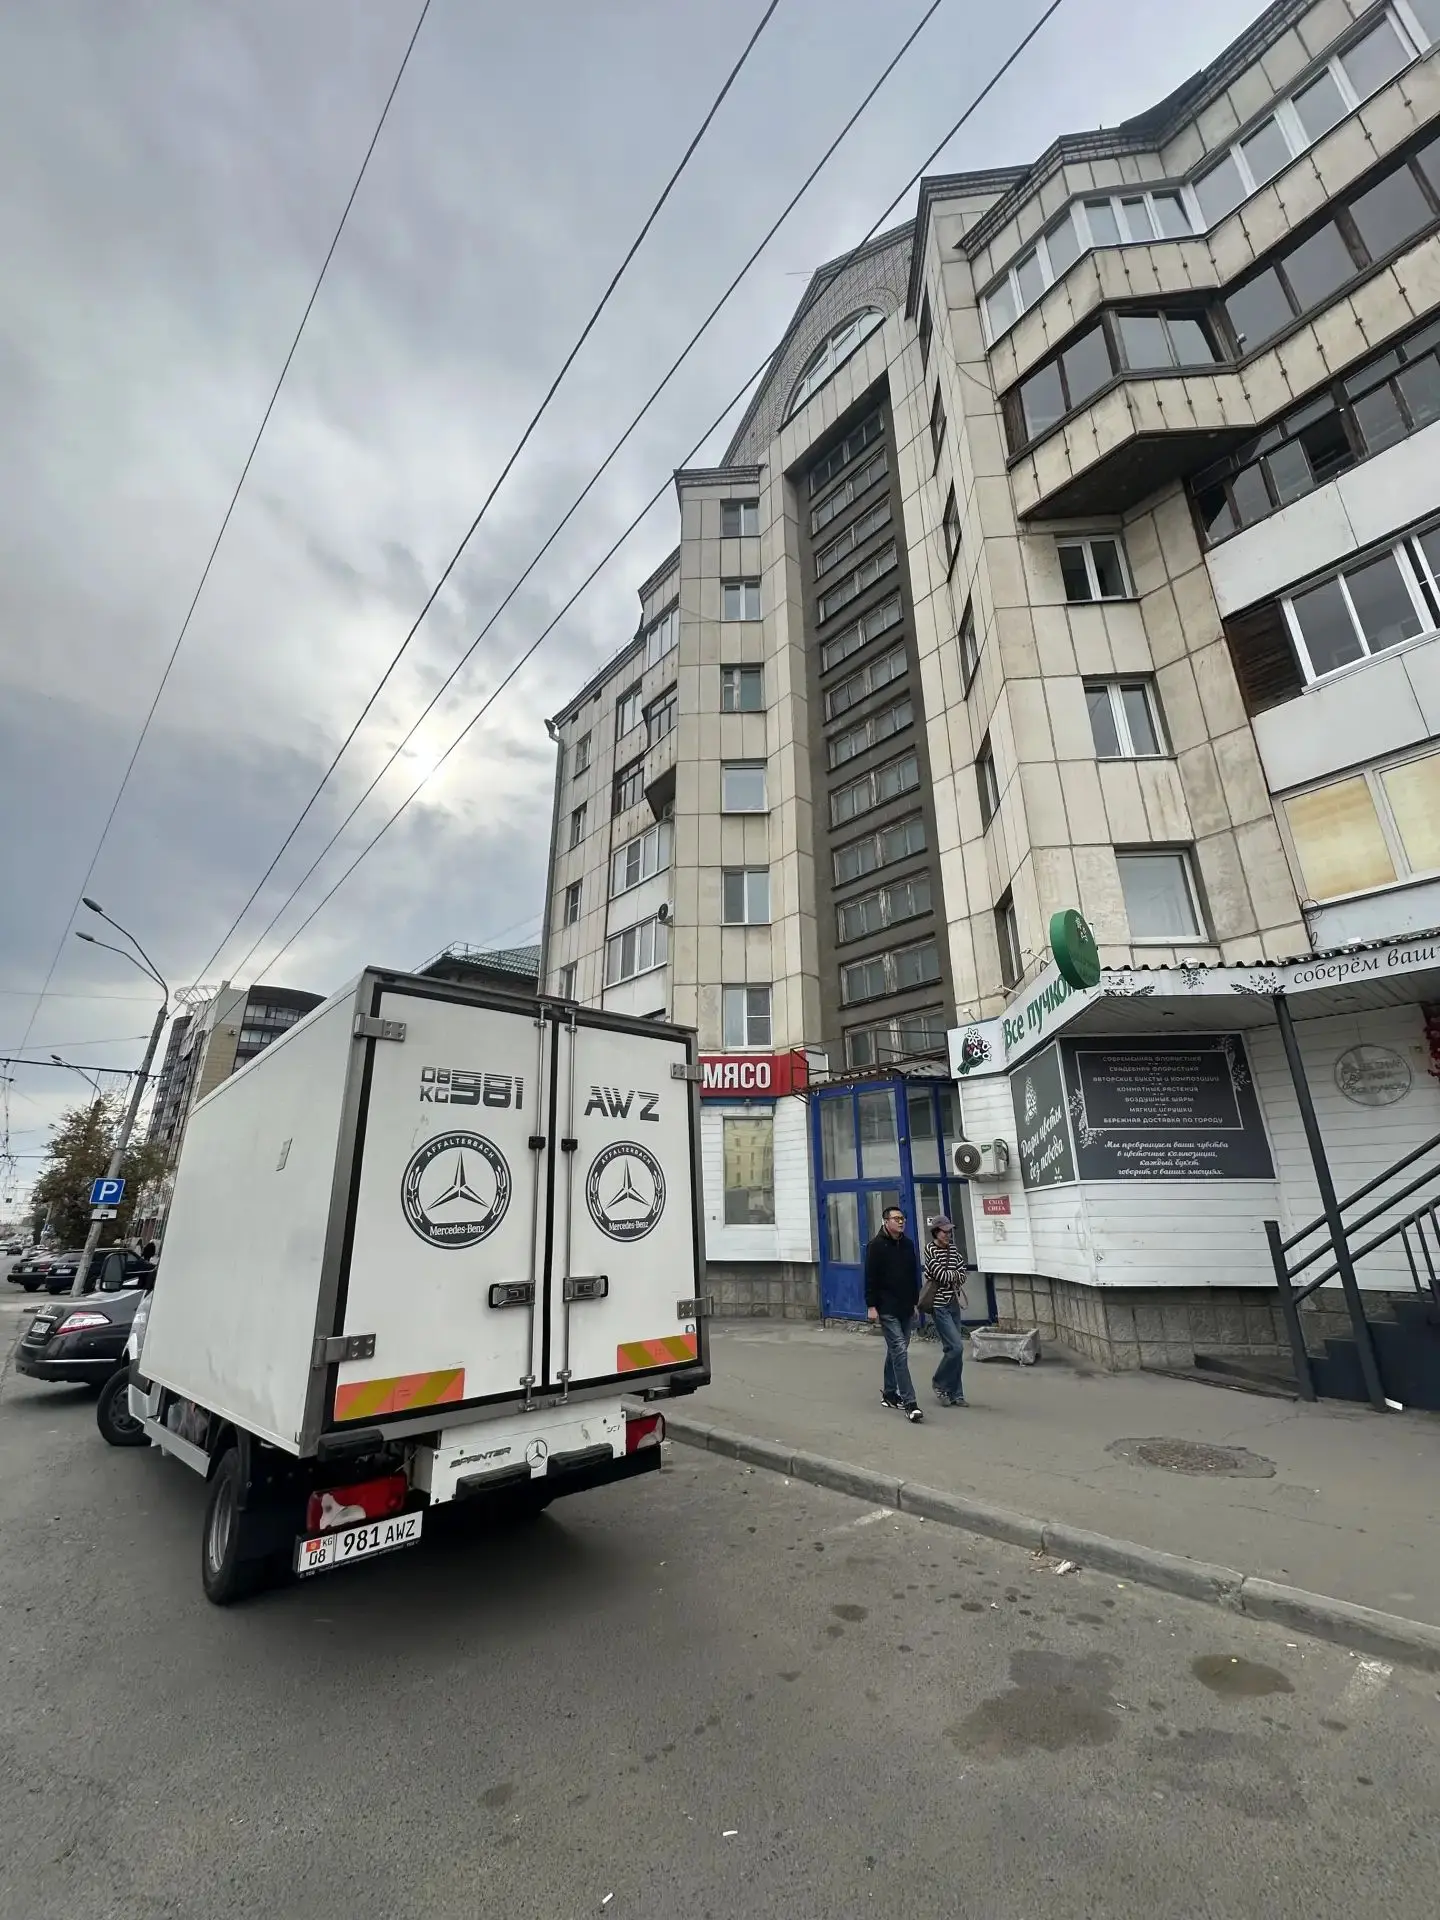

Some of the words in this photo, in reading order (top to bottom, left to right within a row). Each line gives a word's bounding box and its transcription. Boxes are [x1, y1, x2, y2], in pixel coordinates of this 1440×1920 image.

[1293, 956, 1380, 984] соберём
[1387, 945, 1440, 967] ваш
[1002, 1014, 1025, 1049] Все
[702, 1062, 771, 1089] МЯСО
[419, 1085, 450, 1104] KG
[450, 1069, 524, 1110] 981
[583, 1085, 660, 1122] AWZ
[1021, 1131, 1040, 1158] Дари
[1039, 1104, 1062, 1142] цветы
[426, 1137, 495, 1159] AFFALTERBACH
[1040, 1134, 1064, 1172] повода
[1104, 1140, 1120, 1148] Мы
[1121, 1141, 1172, 1150] превращаем
[1173, 1140, 1195, 1148] ваши
[1196, 1140, 1229, 1150] чувства
[1123, 1150, 1165, 1158] цветочные
[600, 1146, 652, 1165] AFFALTERBACH
[1174, 1158, 1199, 1167] букет
[1117, 1168, 1151, 1177] говорит
[99, 1181, 118, 1201] P
[429, 1224, 485, 1236] Mercedes-Benz
[608, 1220, 649, 1232] Mercedes-Benz
[449, 1446, 512, 1469] SPRINTER
[322, 1537, 333, 1547] KG
[343, 1525, 381, 1556] 981
[384, 1519, 416, 1544] AWZ
[308, 1549, 326, 1567] 08
